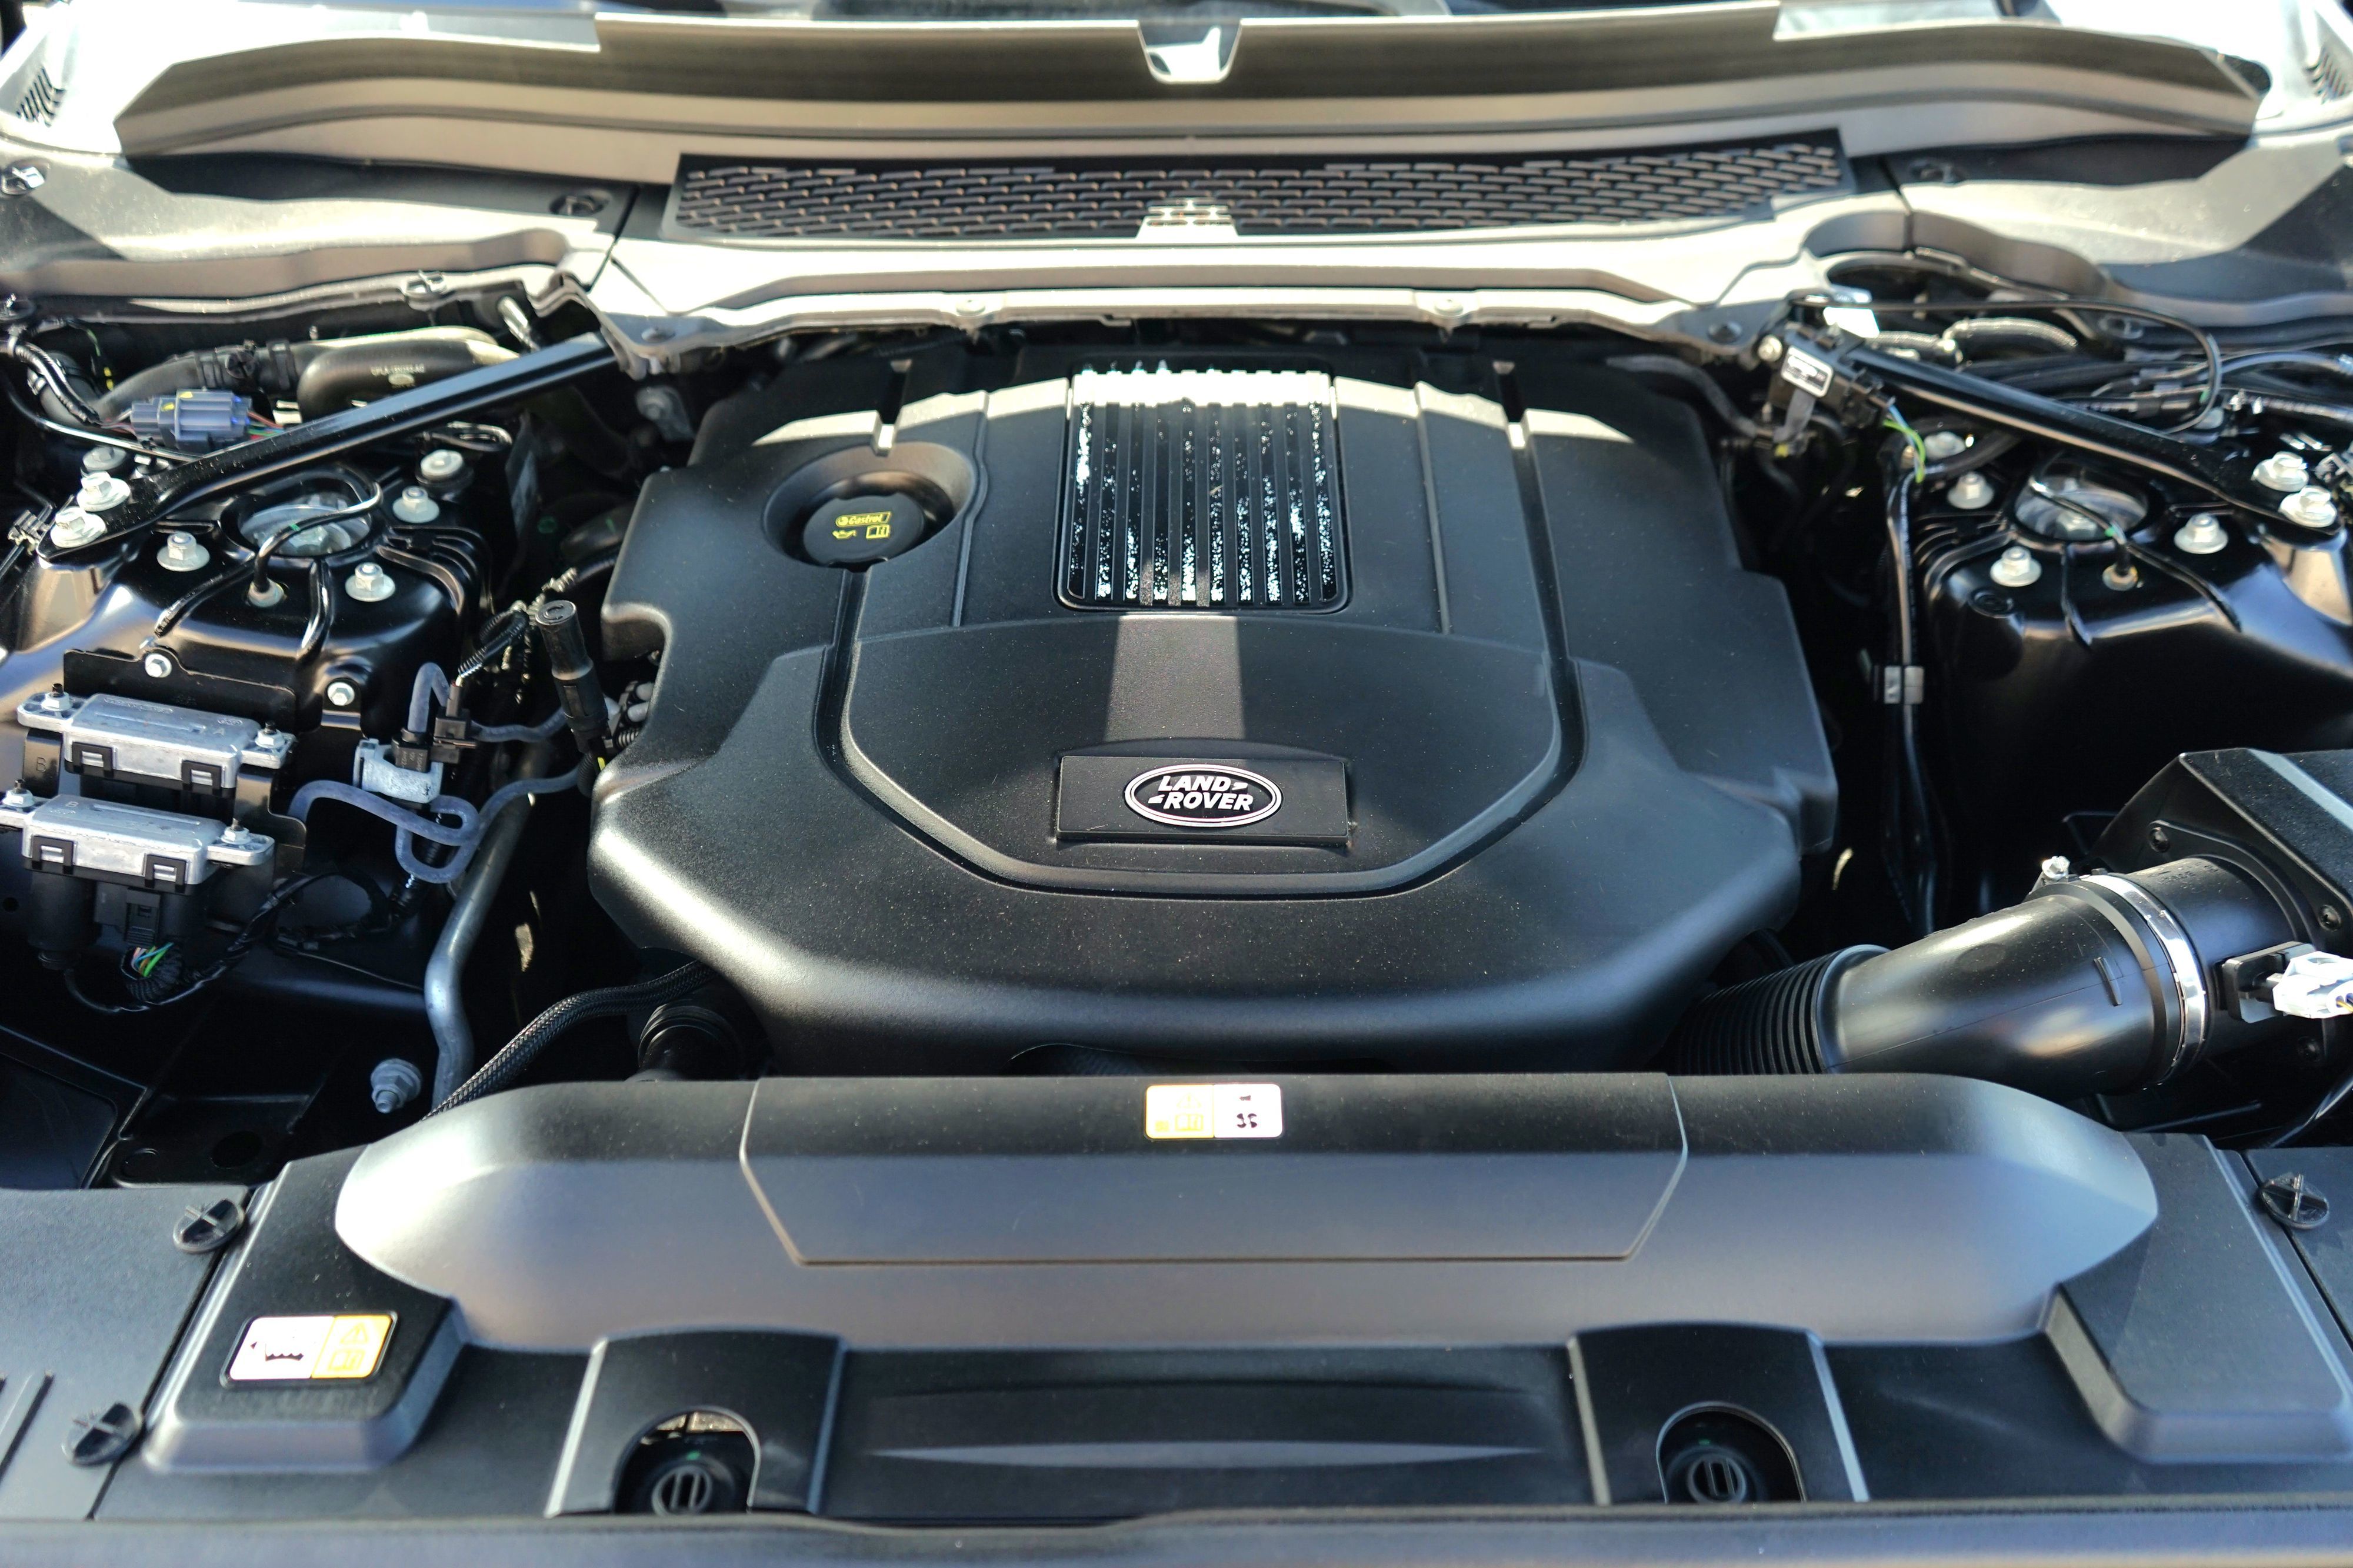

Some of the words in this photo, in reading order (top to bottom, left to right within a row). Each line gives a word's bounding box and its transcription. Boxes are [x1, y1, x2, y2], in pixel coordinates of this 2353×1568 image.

[848, 513, 883, 525] Castrol
[36, 756, 47, 772] B
[1158, 775, 1231, 792] LAND
[1163, 792, 1254, 811] ROVER
